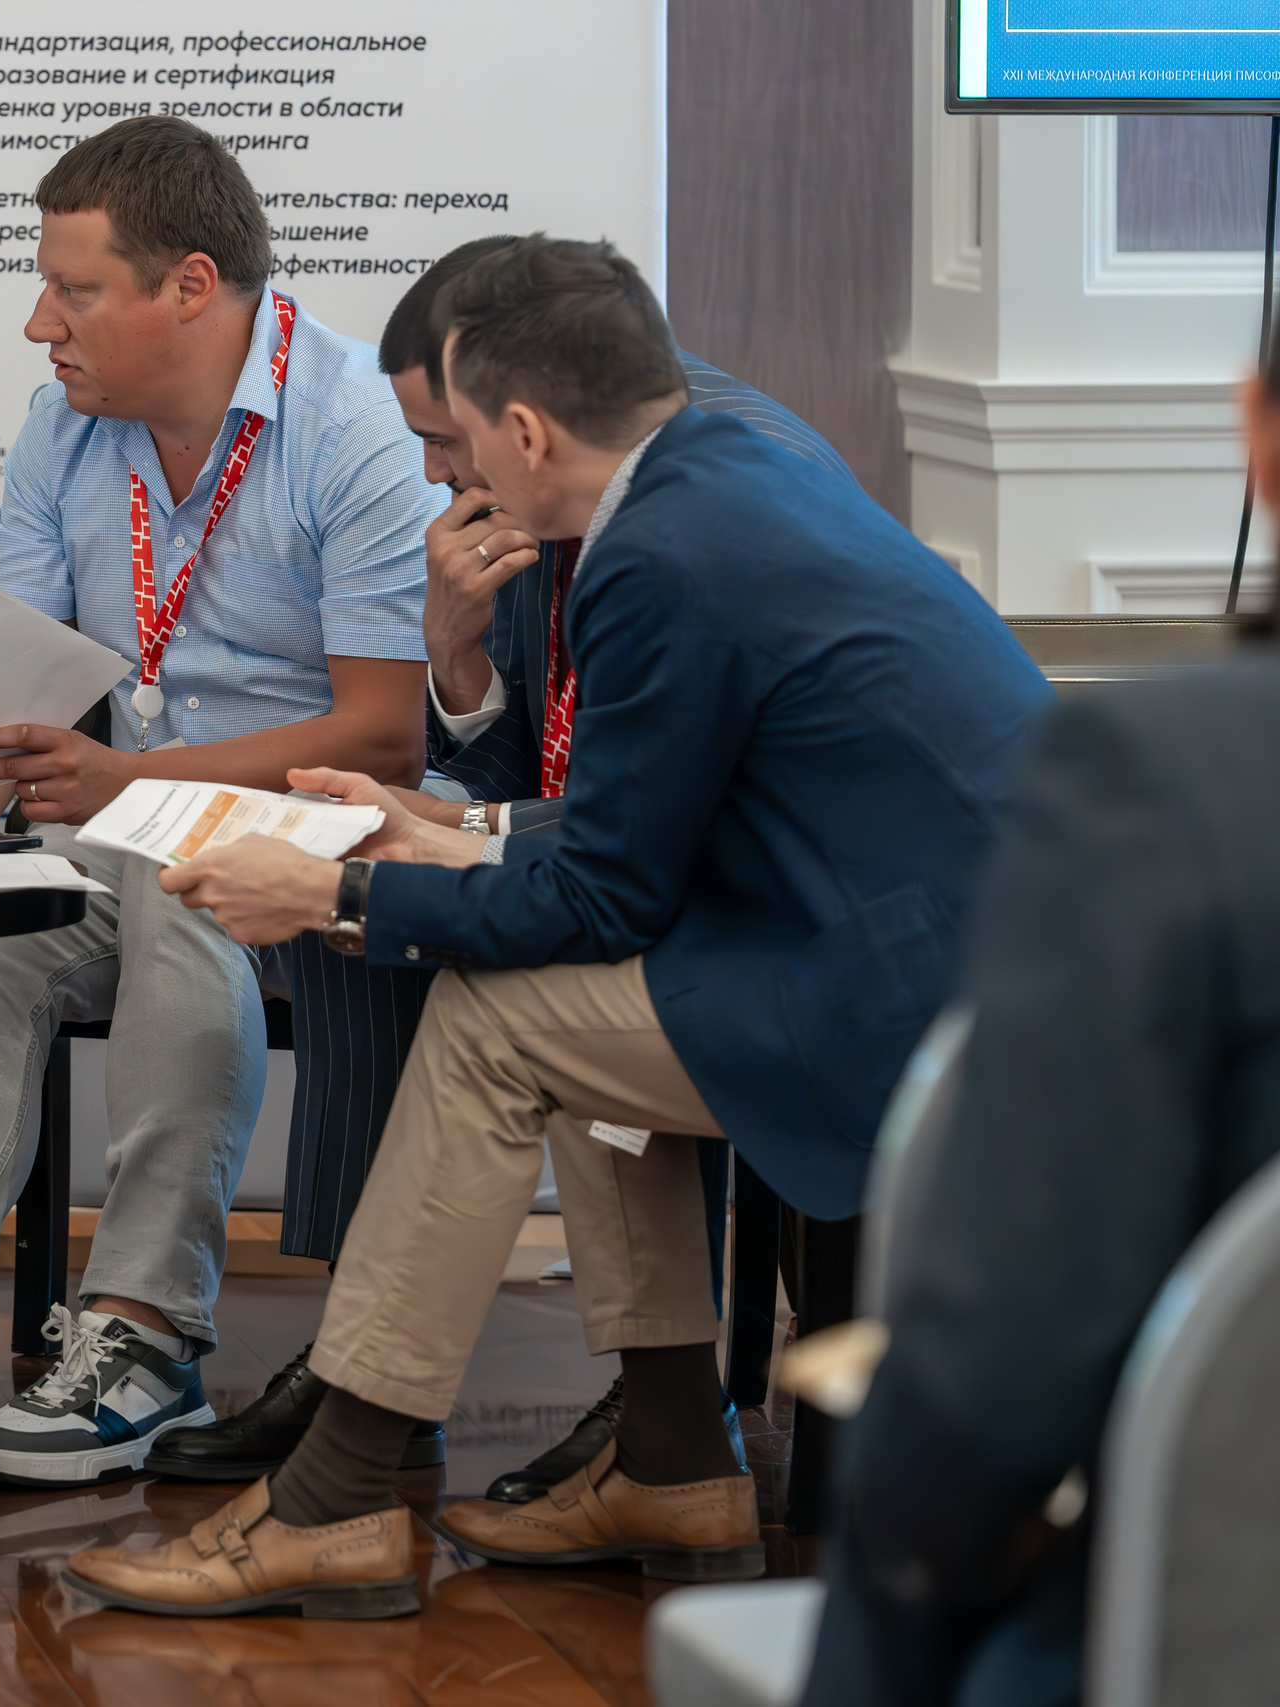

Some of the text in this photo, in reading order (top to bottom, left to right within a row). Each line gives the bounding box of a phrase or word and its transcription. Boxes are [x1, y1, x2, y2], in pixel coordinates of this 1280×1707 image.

[183, 30, 427, 57] профессиональное
[133, 68, 148, 84] и
[155, 62, 335, 89] сертификация
[1003, 69, 1023, 81] XXII
[1027, 69, 1136, 83] МЕЖДУНАРОДНАЯ
[1139, 69, 1232, 83] КОНФЕРЕНЦИЯ
[61, 101, 151, 122] уровня
[158, 101, 273, 117] зрелости
[280, 101, 293, 117] в
[300, 96, 404, 117] области
[404, 192, 509, 214] переход
